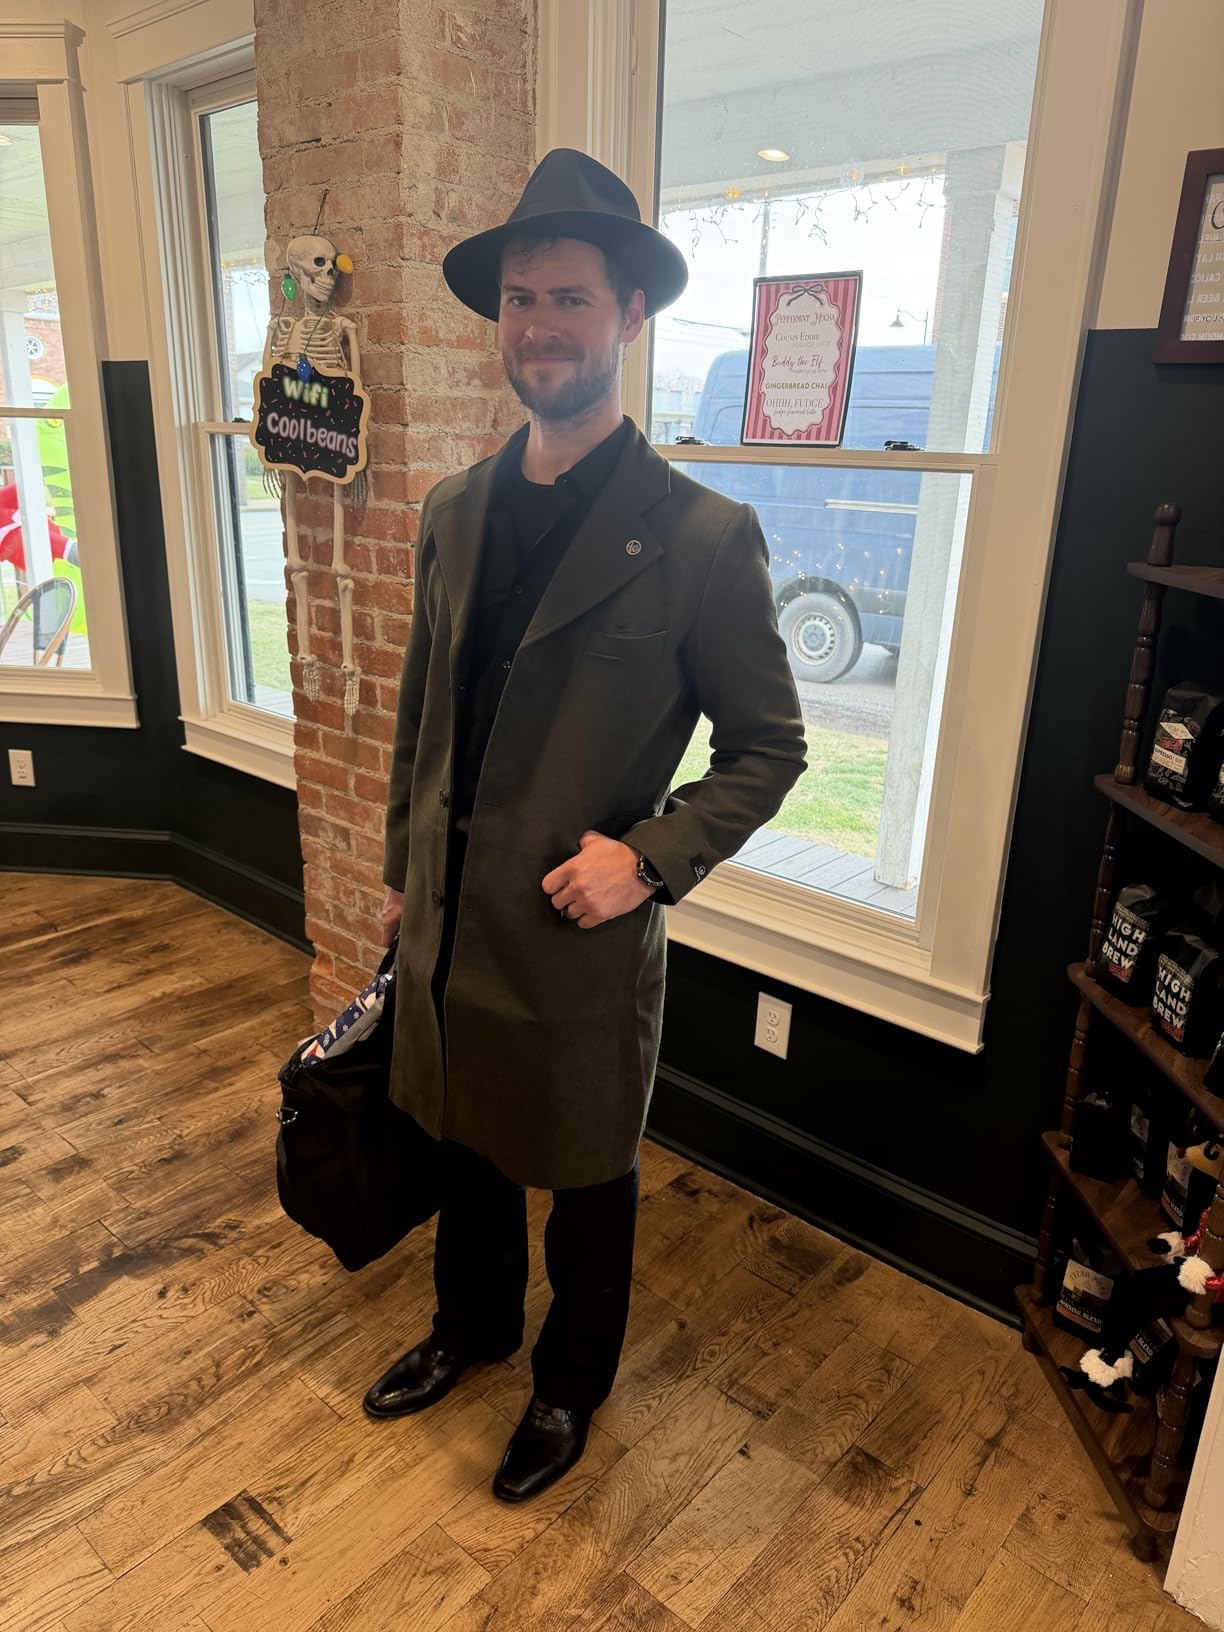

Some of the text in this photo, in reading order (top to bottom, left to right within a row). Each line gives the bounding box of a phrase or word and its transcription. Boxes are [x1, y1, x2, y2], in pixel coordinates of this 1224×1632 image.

[772, 354, 797, 369] Buddy
[797, 354, 809, 366] the
[283, 375, 329, 409] Wifi
[765, 382, 828, 390] GINGERBREAD CHAI
[794, 398, 824, 409] FUDGE
[265, 411, 358, 458] Coolbeans
[1107, 927, 1138, 956] LAND
[1111, 912, 1146, 943] HIGH
[1101, 940, 1135, 969] BREW
[1155, 980, 1187, 1015] LAND
[1158, 967, 1191, 1002] HIGH
[1152, 994, 1185, 1029] BREW
